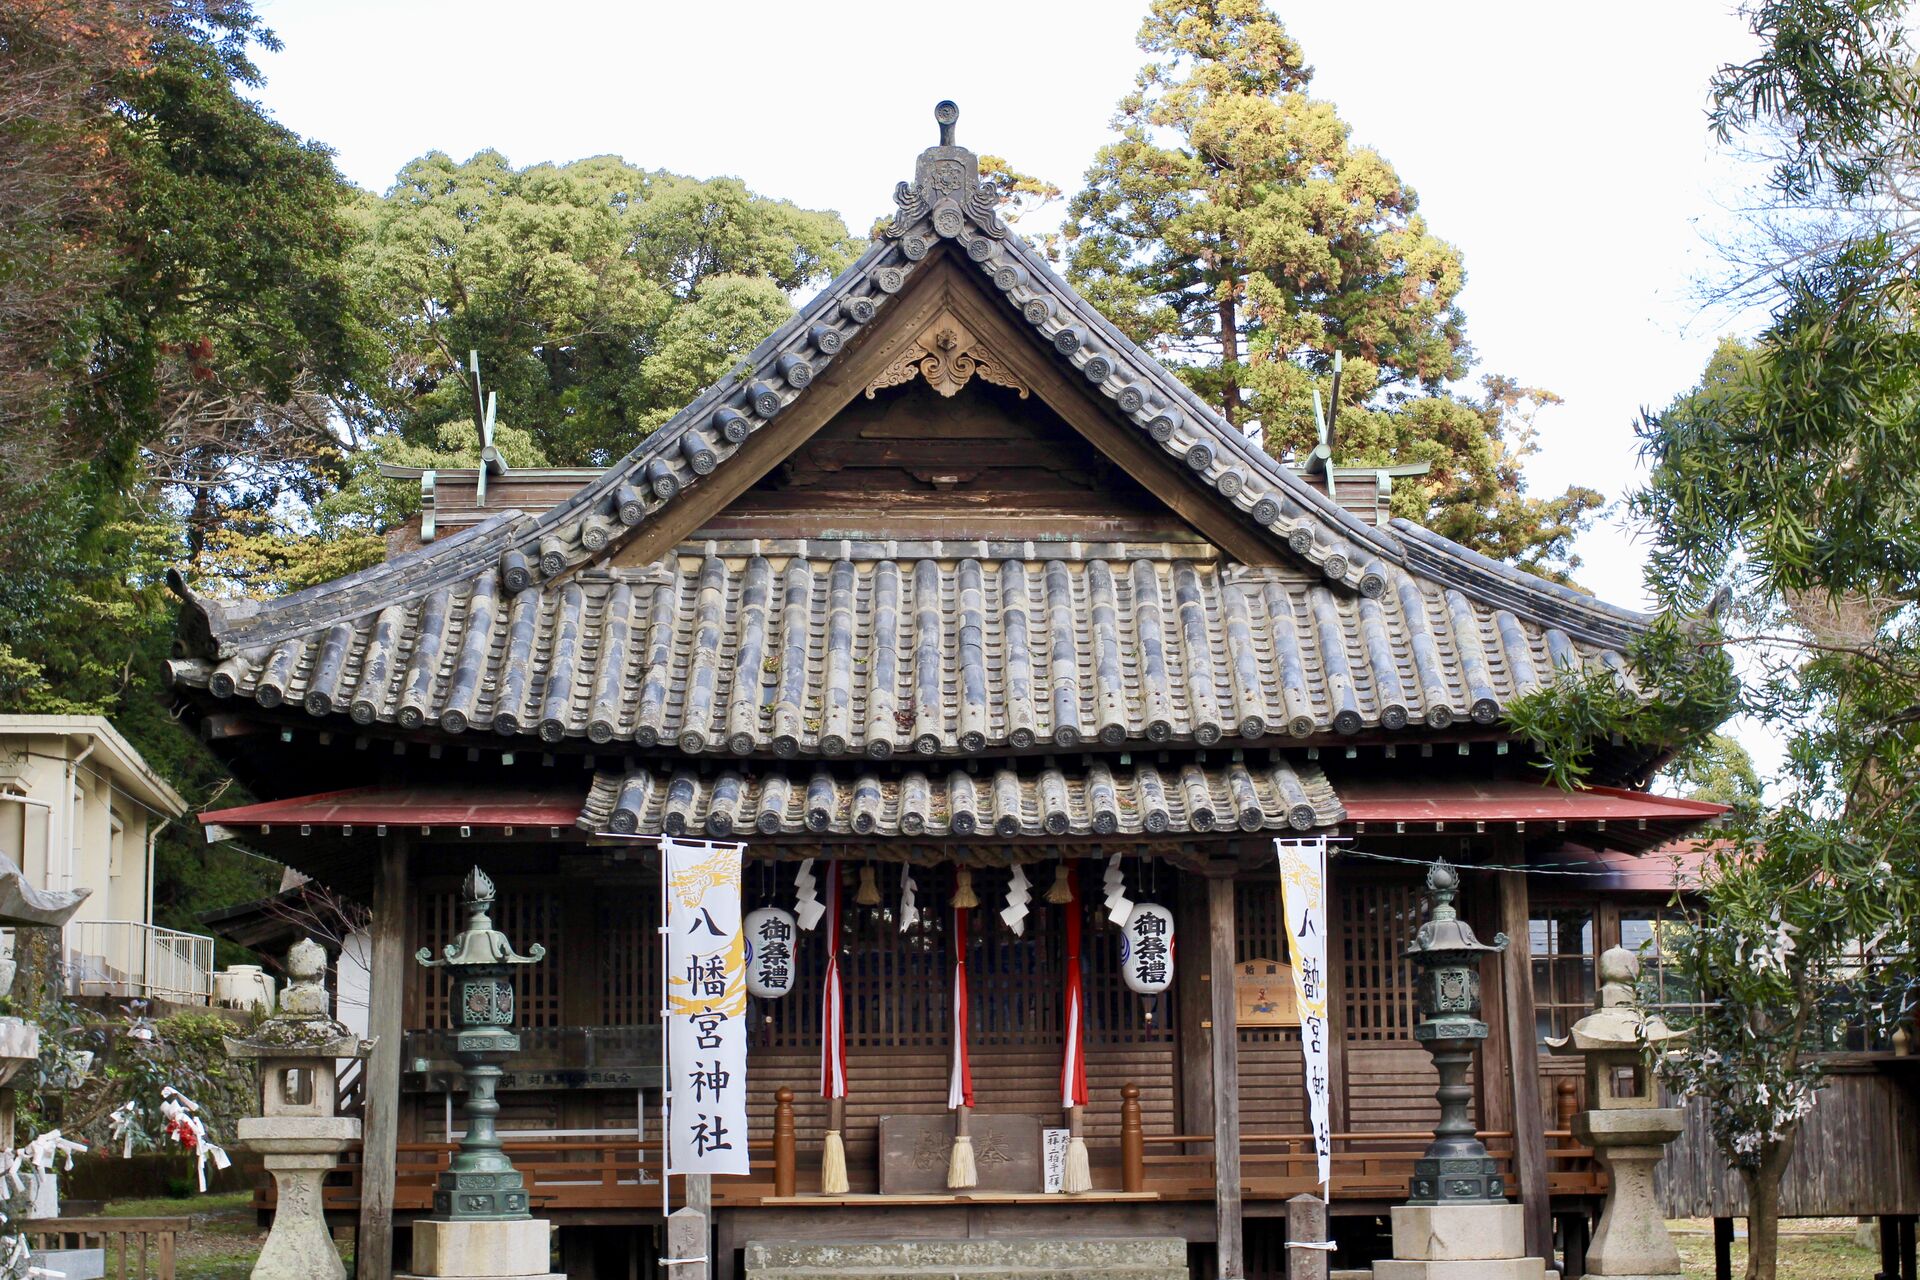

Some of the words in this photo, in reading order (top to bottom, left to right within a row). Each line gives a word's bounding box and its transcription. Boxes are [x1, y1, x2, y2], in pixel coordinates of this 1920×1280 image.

[759, 917, 790, 989] 御祭禮
[1134, 912, 1166, 983] 御祭禮
[688, 907, 732, 1157] 八幡宮神社
